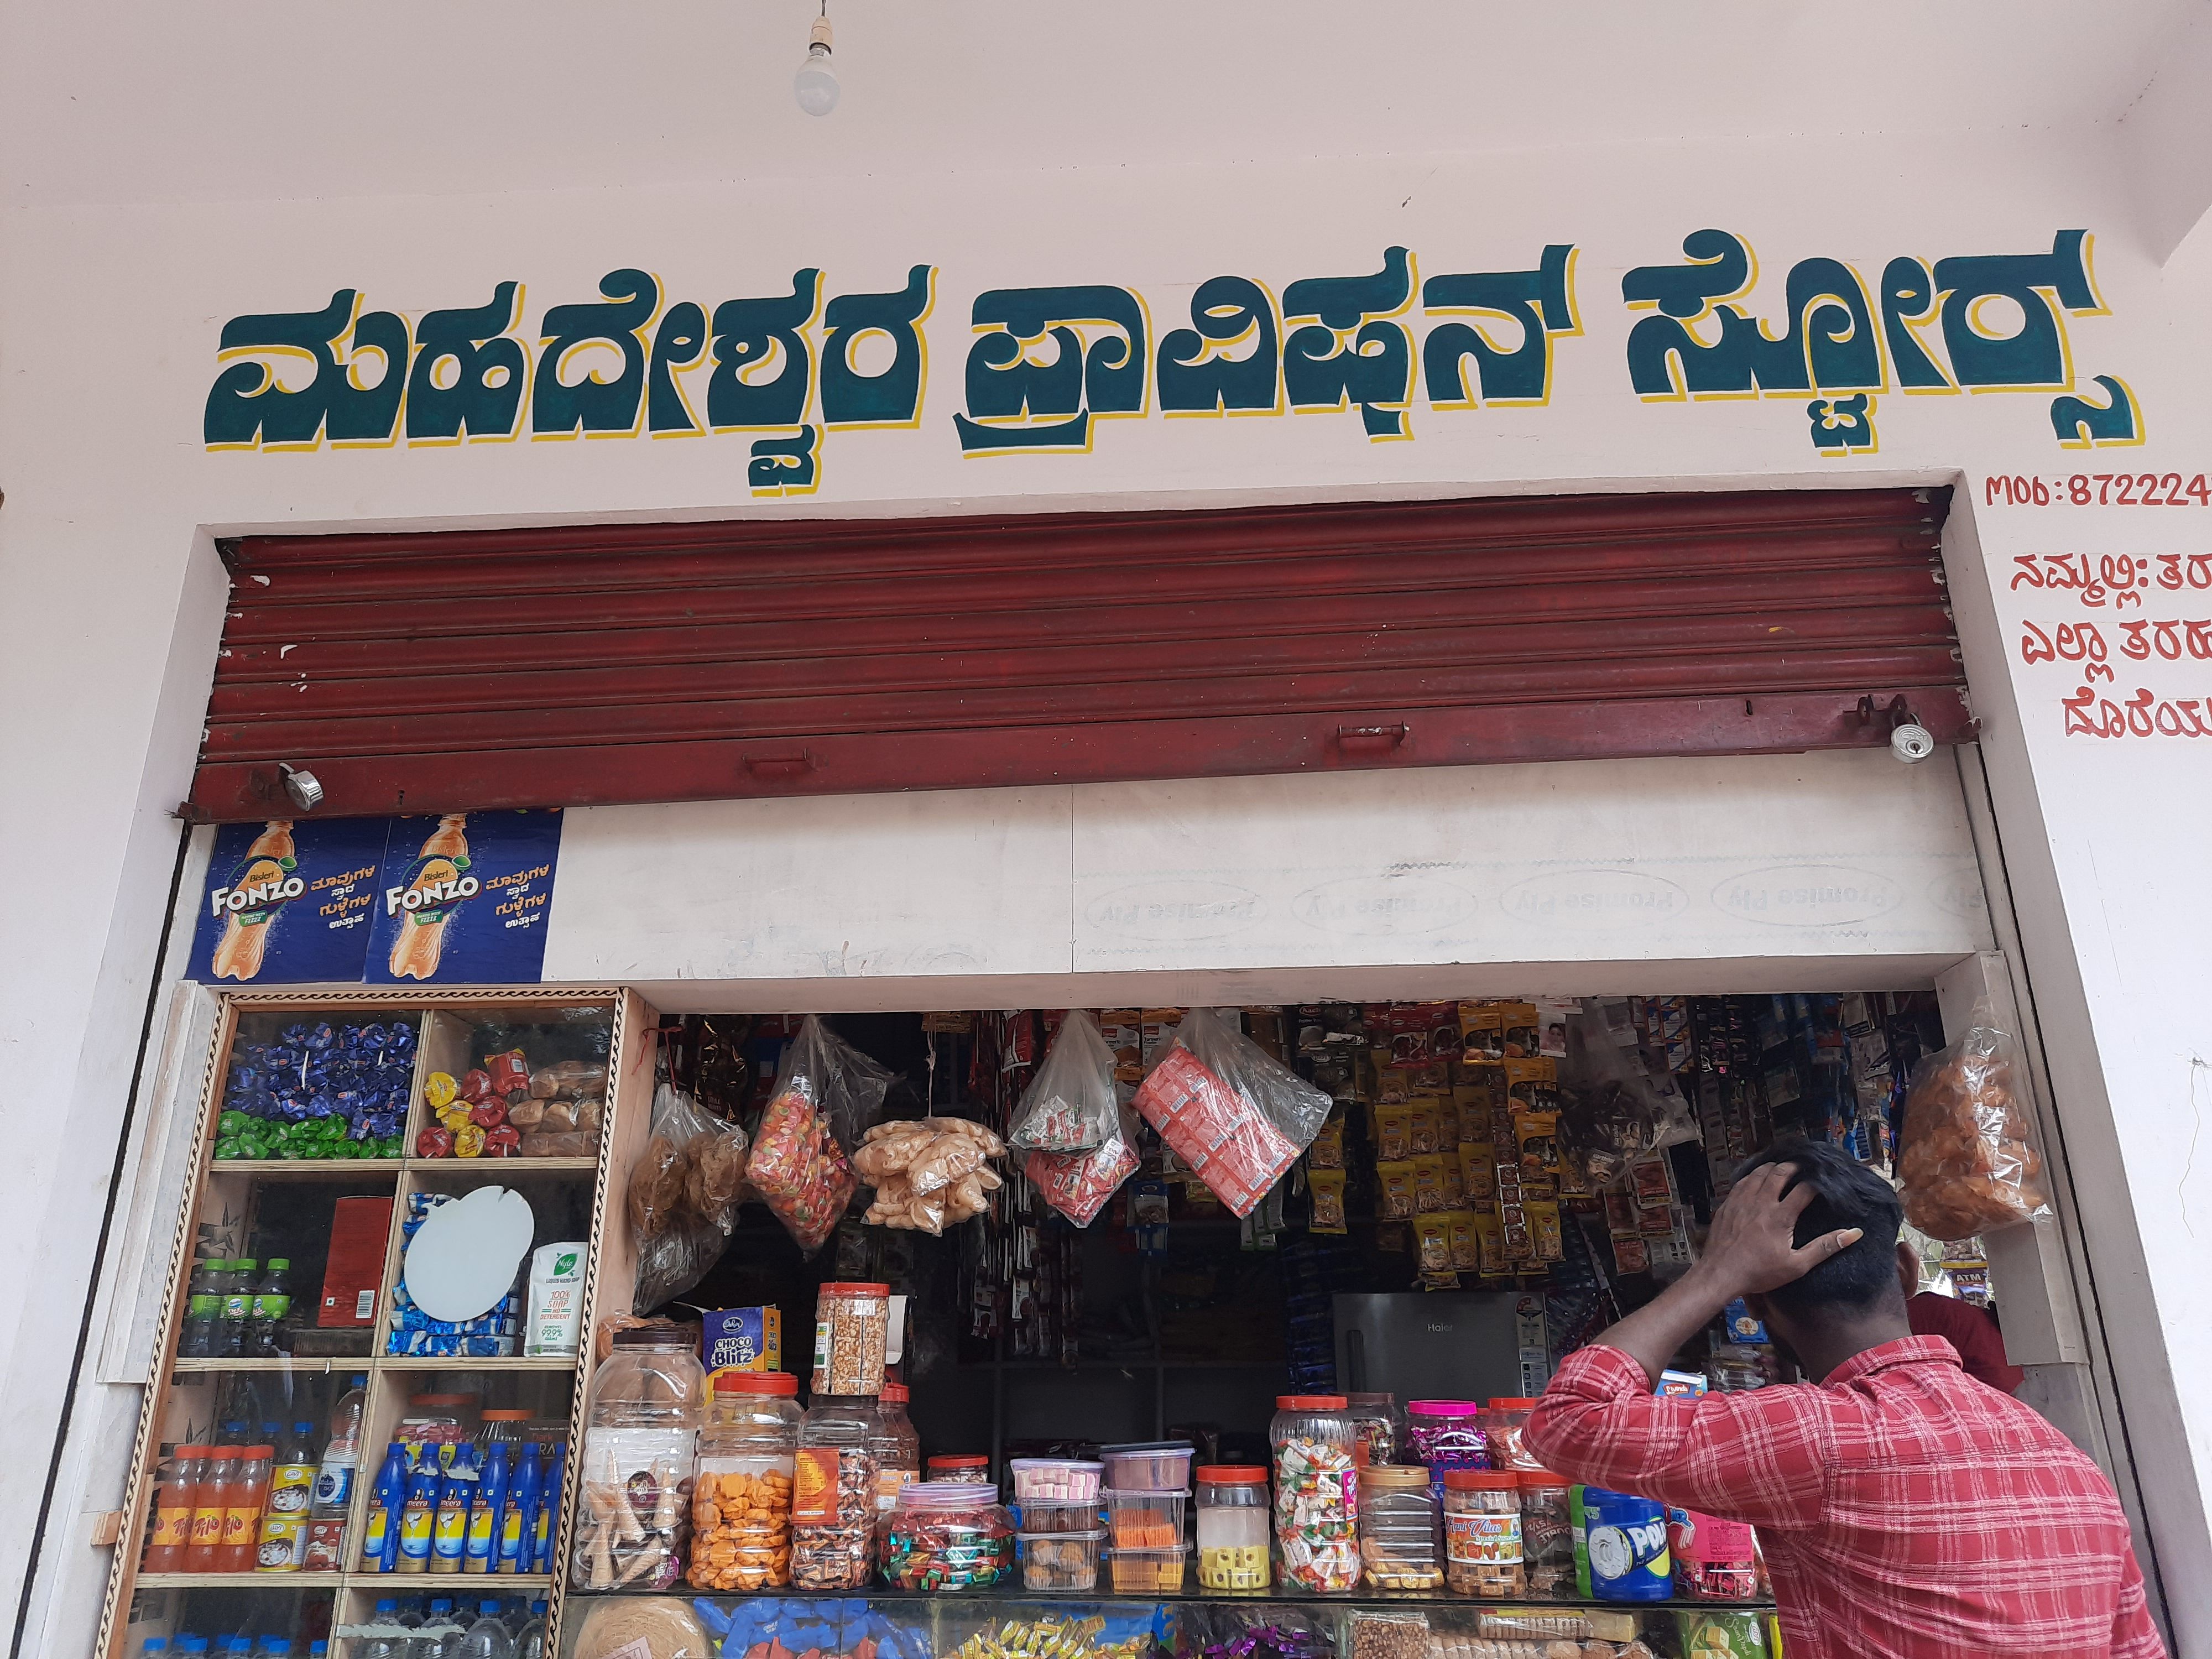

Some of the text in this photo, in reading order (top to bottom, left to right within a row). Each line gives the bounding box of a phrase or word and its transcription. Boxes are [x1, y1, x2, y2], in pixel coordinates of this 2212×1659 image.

[204, 264, 938, 497] ಮಹದೇಶ್ವರ
[249, 870, 274, 883] Bisleri
[211, 878, 305, 917] FONZO
[386, 877, 479, 916] FONZO
[558, 1259, 573, 1270] Nyle
[1957, 1274, 1981, 1282] ATM
[551, 1290, 571, 1299] 100%
[715, 1337, 753, 1349] CHOCO
[713, 1348, 754, 1366] Blitz
[1468, 1519, 1503, 1537] Vilas
